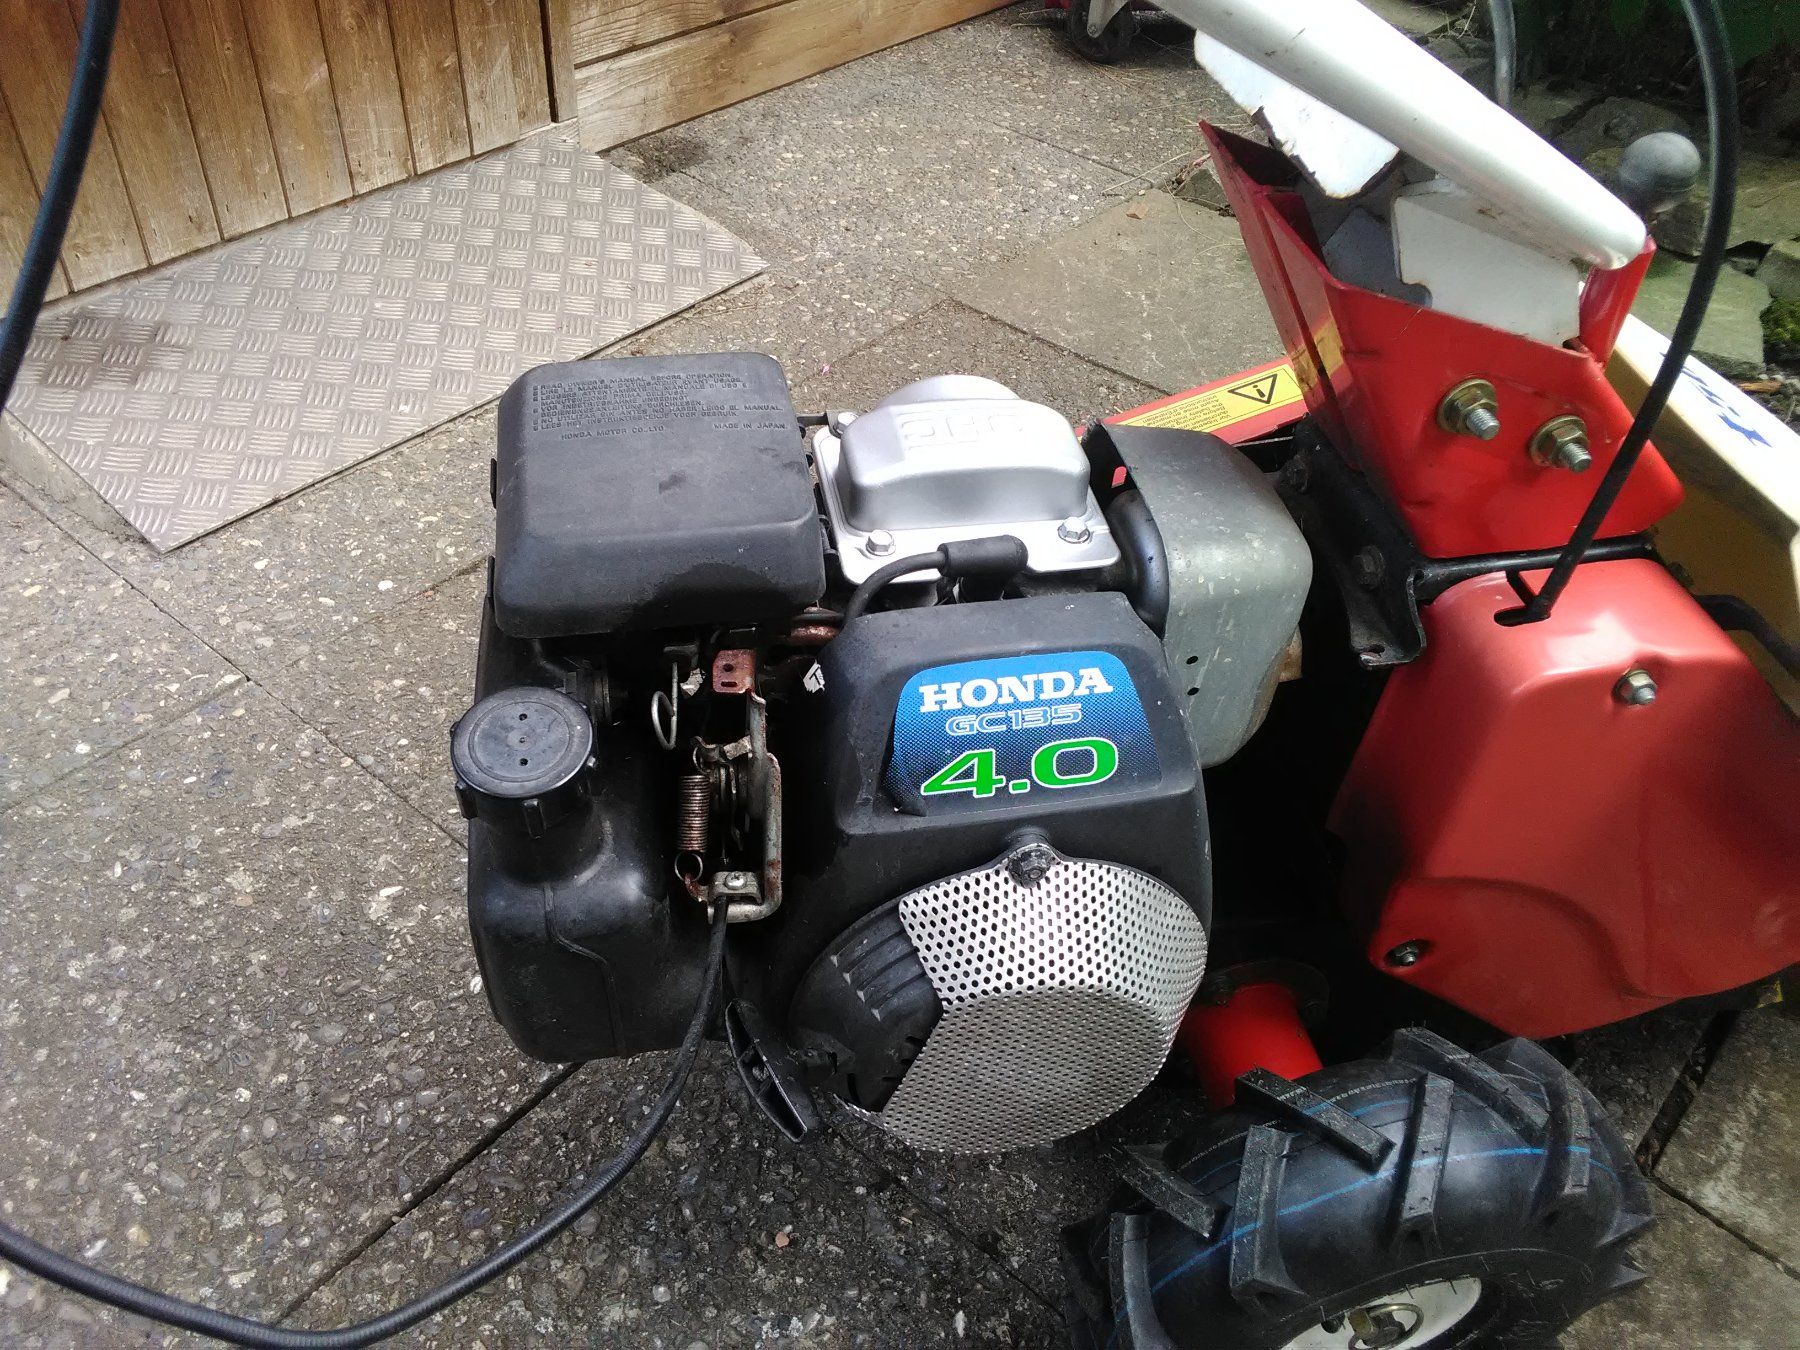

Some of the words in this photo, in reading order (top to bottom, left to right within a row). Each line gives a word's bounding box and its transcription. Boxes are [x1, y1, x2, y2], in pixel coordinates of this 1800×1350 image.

[578, 383, 614, 391] MANUEL
[683, 378, 709, 386] AVANT
[610, 376, 646, 384] MANUAL
[664, 383, 705, 391] MANUALE
[613, 391, 641, 399] PRIMA
[541, 422, 561, 430] LEES
[561, 431, 593, 440] HONDA
[597, 428, 627, 437] MOTOR
[919, 667, 1114, 713] HONDA
[945, 703, 1083, 736] GC135
[920, 736, 1119, 798] 4.0
